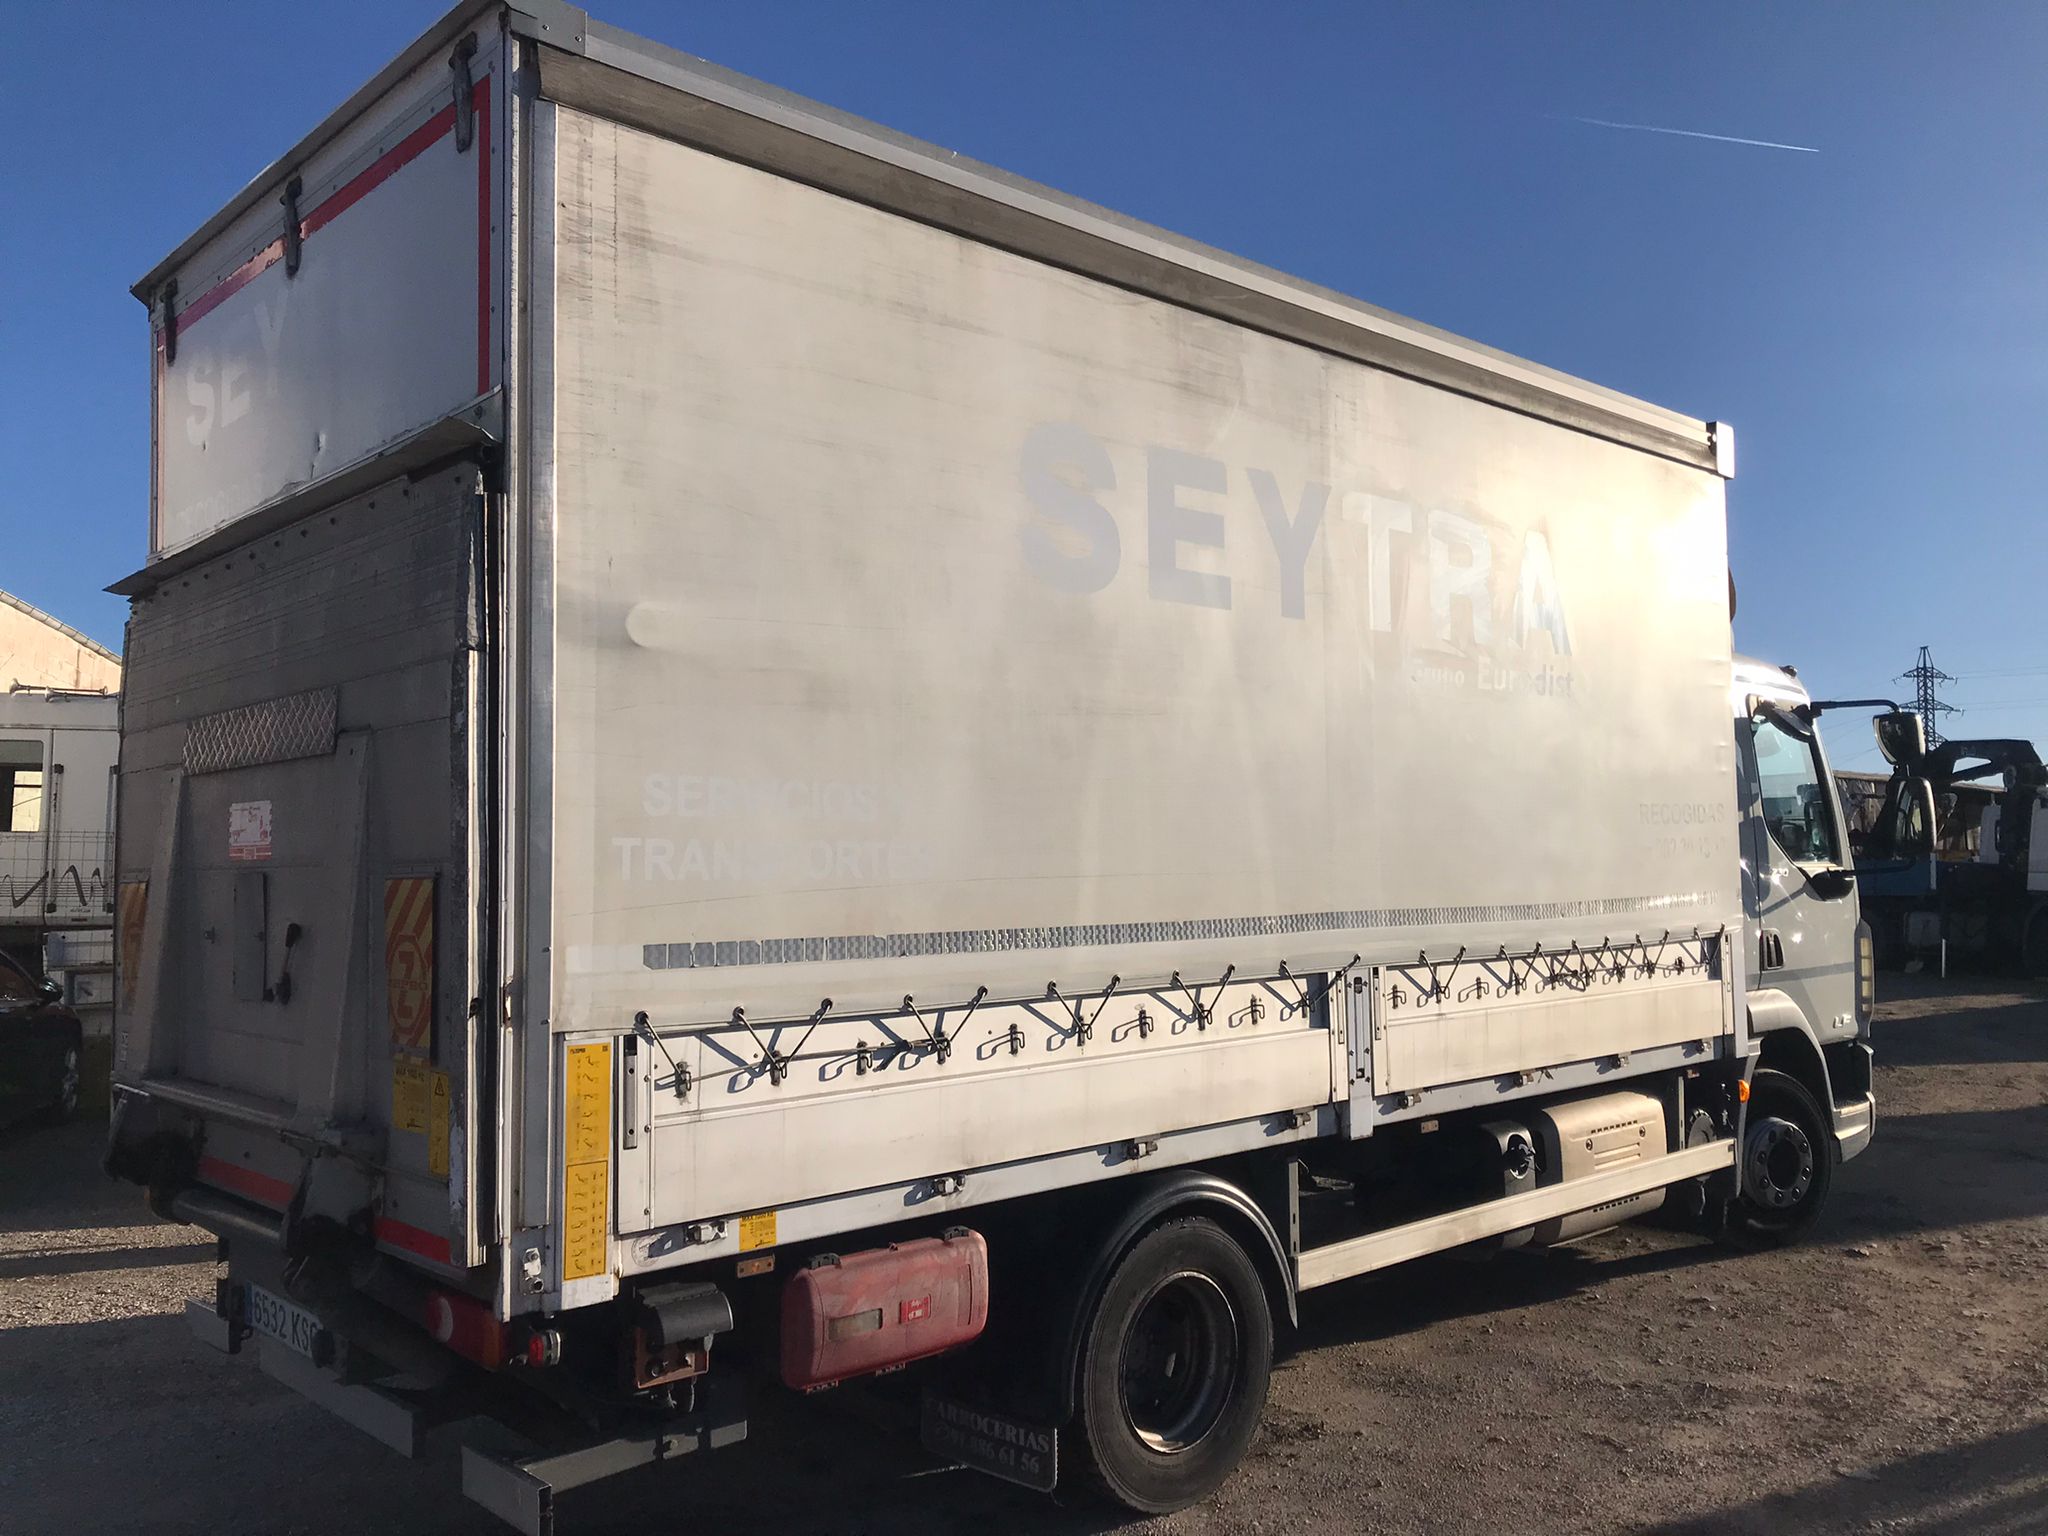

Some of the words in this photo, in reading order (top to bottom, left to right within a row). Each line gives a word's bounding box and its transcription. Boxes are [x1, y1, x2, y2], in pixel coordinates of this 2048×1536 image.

[1020, 421, 1573, 657] SEYTRA
[1639, 802, 1725, 824] RECOGIDAS
[253, 1292, 287, 1339] 6532
[1020, 1452, 1040, 1475] 56
